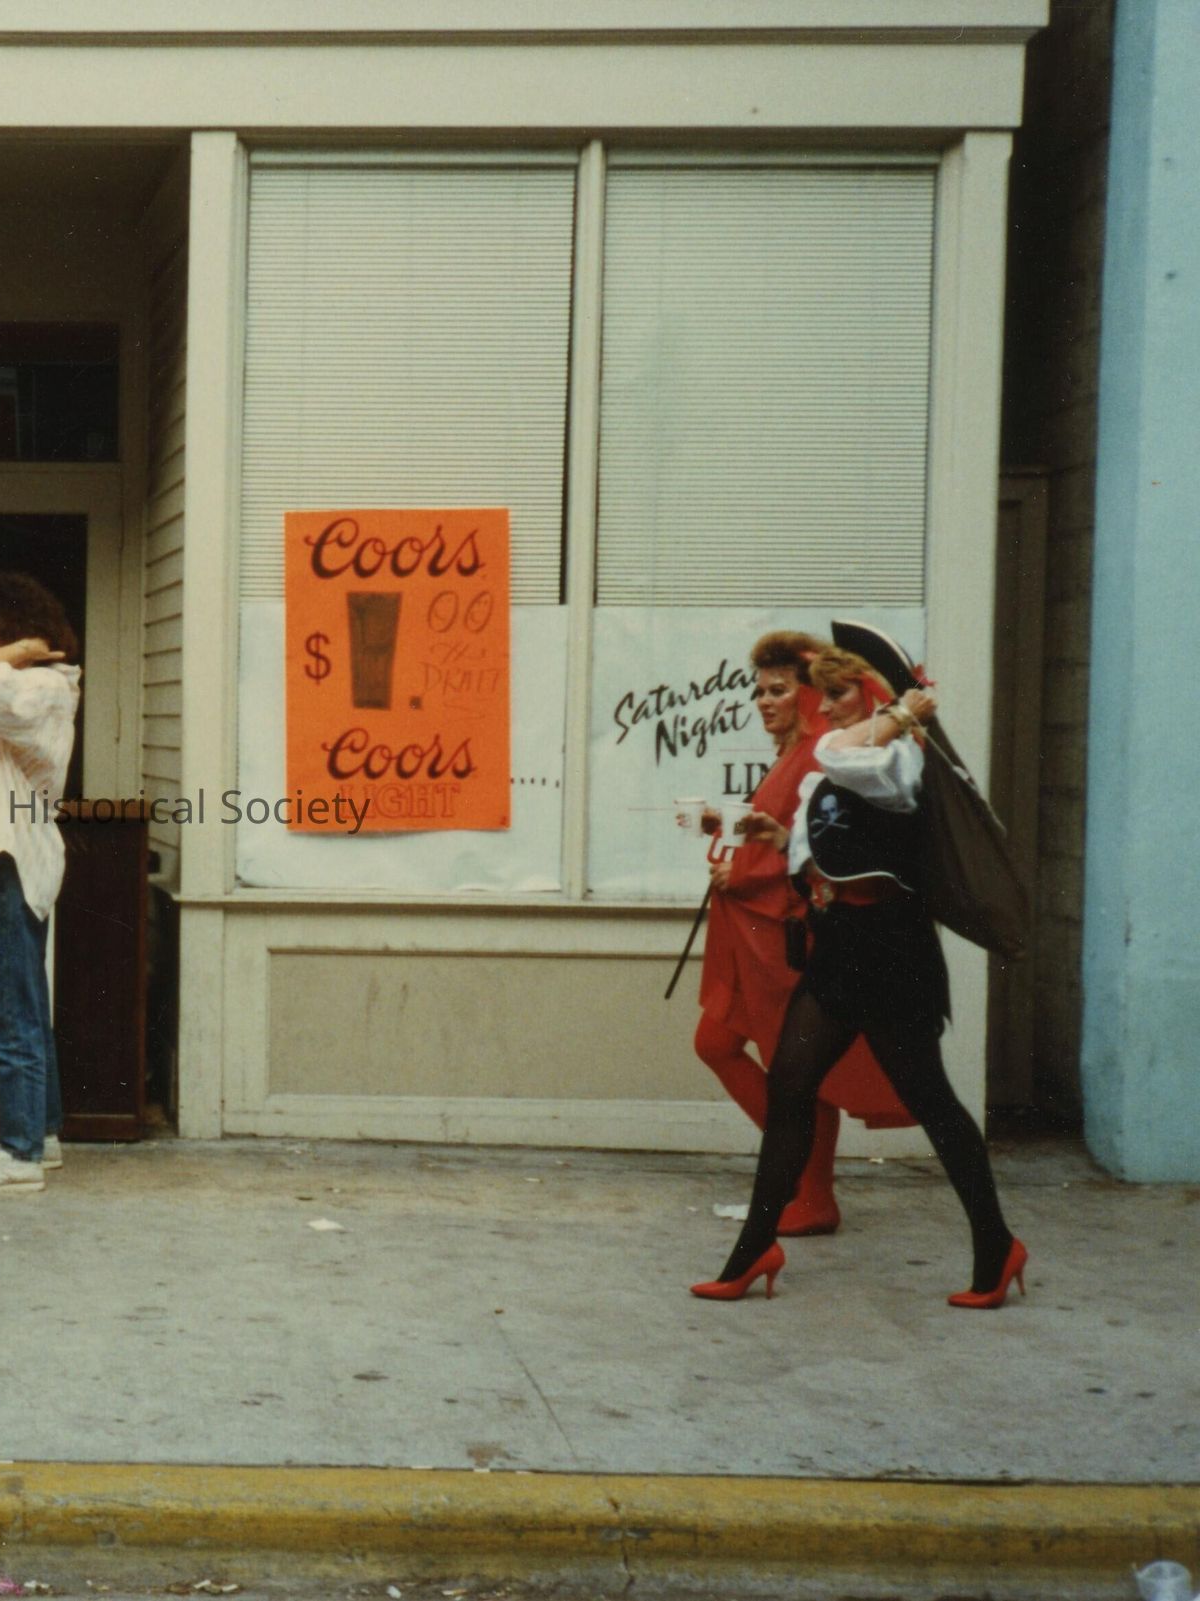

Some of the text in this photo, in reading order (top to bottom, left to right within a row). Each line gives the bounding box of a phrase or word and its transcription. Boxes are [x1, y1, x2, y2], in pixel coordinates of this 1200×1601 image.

[304, 518, 486, 580] Coors
[321, 727, 478, 781] Coors
[655, 699, 753, 769] Night
